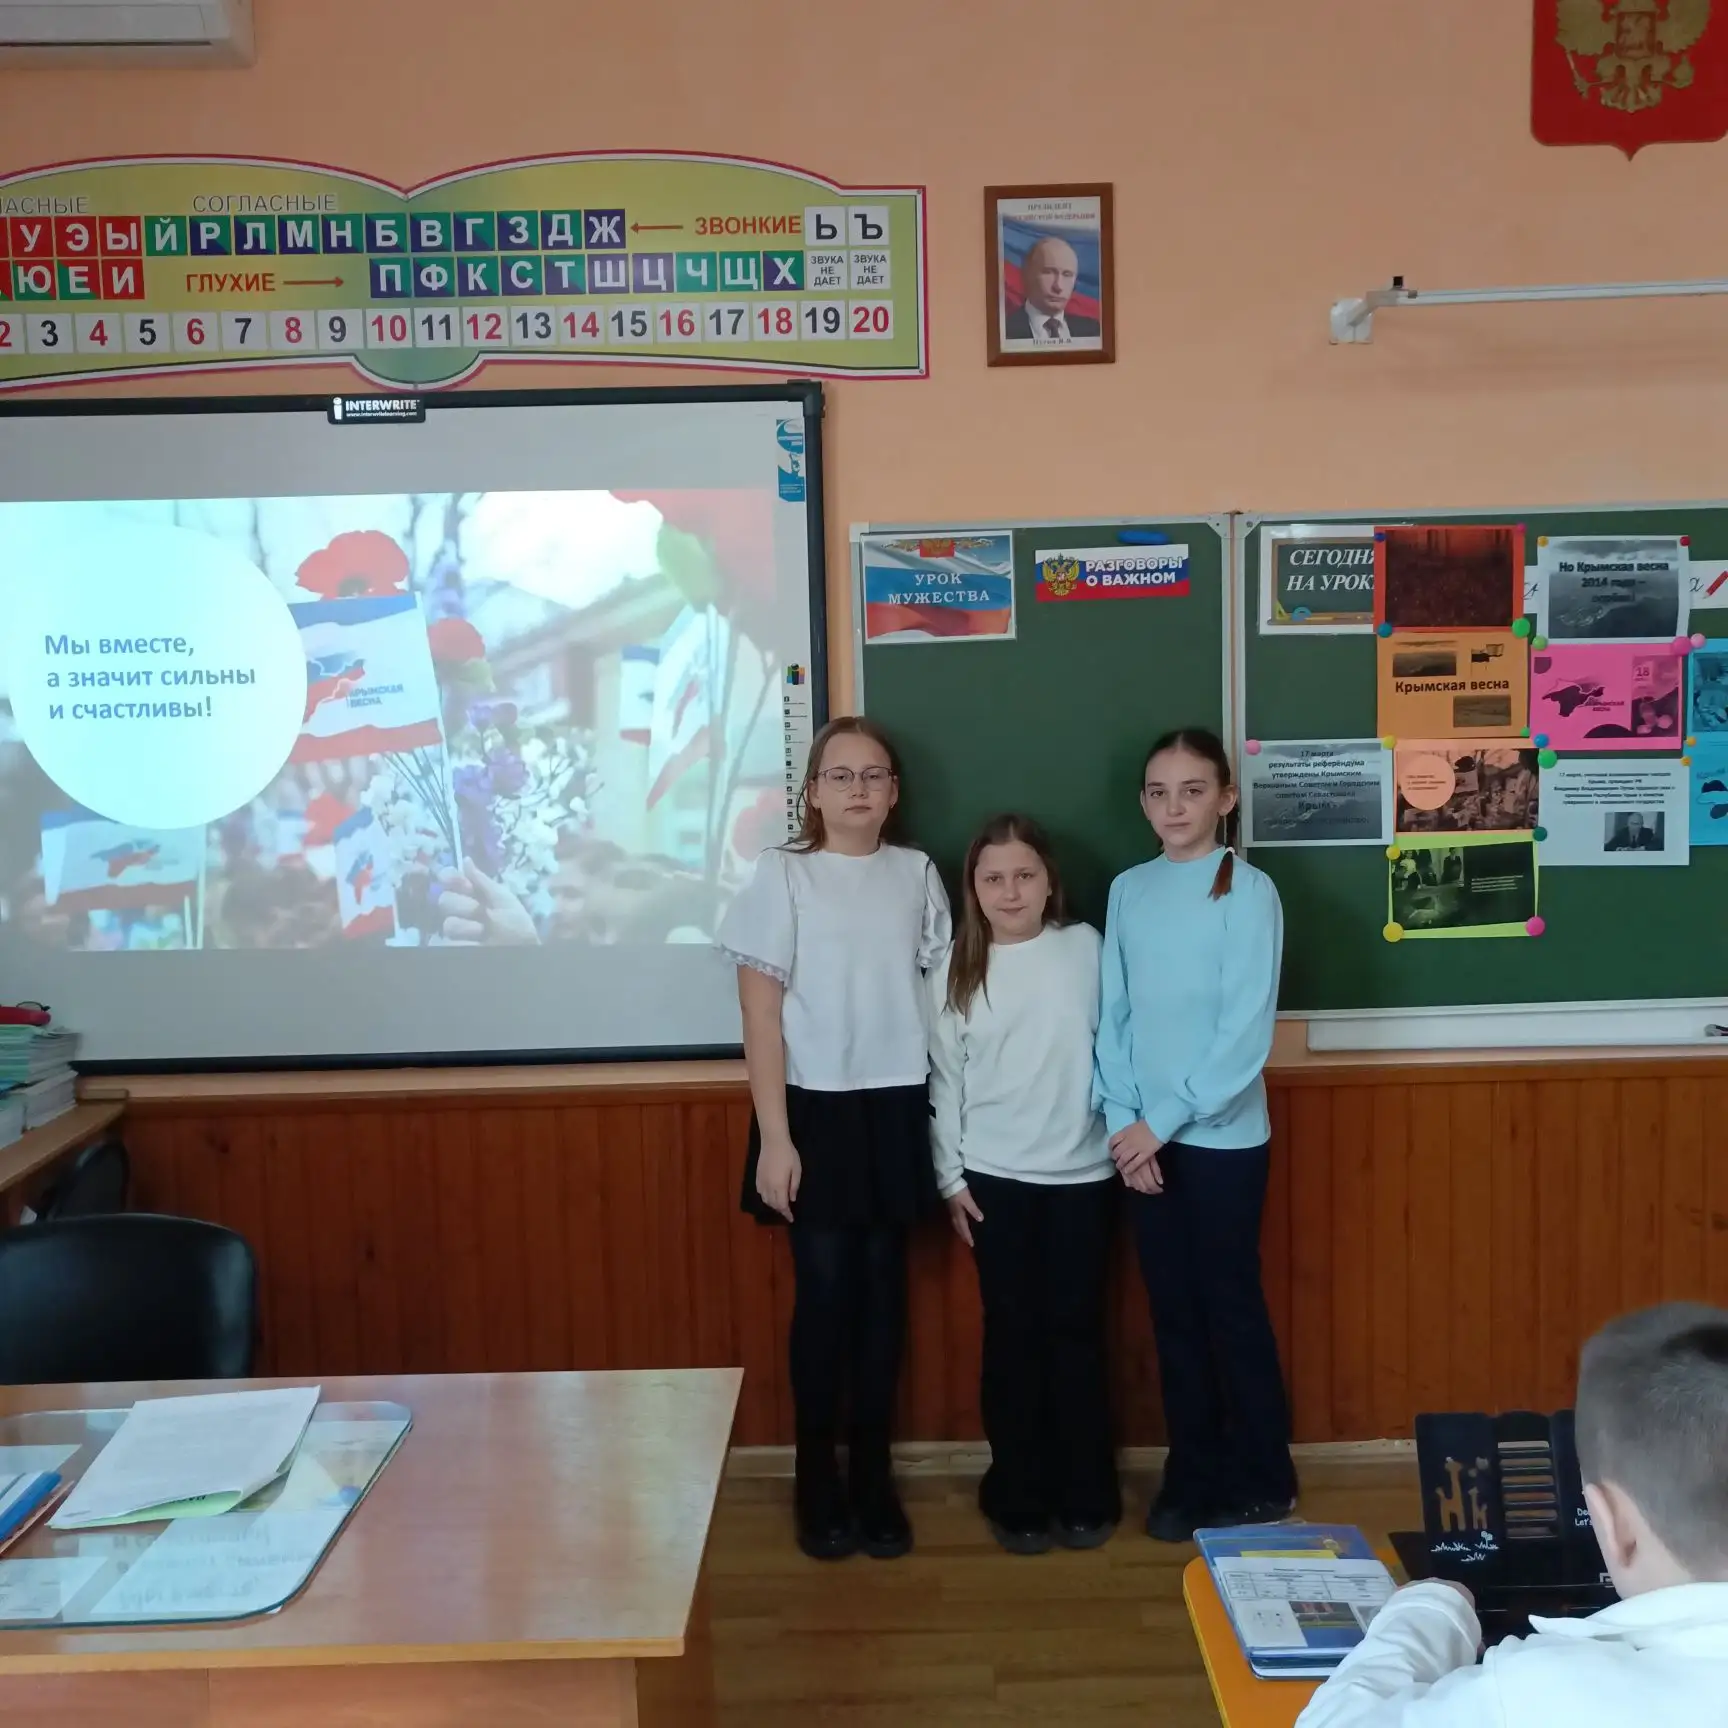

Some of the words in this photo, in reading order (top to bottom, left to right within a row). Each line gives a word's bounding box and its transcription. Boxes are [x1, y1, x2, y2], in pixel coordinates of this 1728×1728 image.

[0, 197, 89, 214] АСНЫЕ
[193, 194, 338, 213] СОГЛАСНЫЕ
[20, 225, 42, 252] У
[66, 223, 90, 251] Э
[106, 223, 138, 250] Ы
[155, 217, 179, 251] Й
[200, 222, 221, 250] Р
[243, 223, 267, 250] Л
[287, 222, 313, 248] М
[330, 221, 352, 247] Н
[376, 220, 399, 247] Б
[421, 220, 443, 247] В
[465, 218, 484, 246] Г
[509, 216, 529, 244] З
[547, 214, 573, 246] Д
[589, 216, 620, 243] Ж
[694, 215, 801, 236] ЗВОНКИЕ
[854, 214, 883, 240] Ъ
[811, 255, 843, 264] ЗВУКА
[854, 254, 887, 263] ЗВУКА
[380, 263, 401, 291] П
[420, 263, 448, 291] Ф
[469, 263, 487, 291] К
[510, 260, 534, 288] С
[555, 261, 576, 288] Т
[594, 260, 626, 287] Ш
[642, 259, 667, 290] Ц
[687, 258, 709, 286] Ч
[725, 257, 758, 289] Щ
[773, 257, 796, 285] Х
[821, 266, 834, 275] НЕ
[864, 265, 877, 273] НЕ
[17, 265, 51, 294] Ю
[68, 265, 90, 294] Е
[112, 266, 135, 295] И
[186, 272, 276, 292] ГЛУХИЕ
[814, 276, 841, 287] ДАЕТ
[857, 275, 884, 286] ДАЕТ
[41, 320, 58, 346] 3
[89, 319, 108, 346] 4
[139, 319, 156, 345] 5
[187, 318, 205, 345] 6
[234, 318, 252, 344] 7
[285, 317, 302, 343] 8
[329, 316, 347, 342] 9
[372, 315, 407, 341] 10
[422, 314, 452, 341] 11
[466, 313, 502, 340] 12
[516, 312, 552, 339] 13
[563, 311, 599, 338] 14
[611, 310, 647, 338] 15
[660, 309, 695, 337] 16
[710, 309, 745, 336] 17
[758, 307, 793, 335] 18
[805, 306, 840, 334] 19
[853, 306, 889, 333] 20
[345, 399, 417, 411] INTERWRITE
[1085, 557, 1183, 573] РАЗГОВОРЫ
[1559, 562, 1574, 572] Но
[914, 572, 963, 585] УРОК
[1086, 575, 1097, 587] О
[1101, 572, 1176, 586] ВАЖНОМ
[1286, 575, 1315, 591] НА
[1320, 574, 1374, 591] УРОК
[888, 590, 990, 605] МУЖЕСТВА
[45, 635, 90, 655] Мы
[99, 637, 194, 656] вместе,
[47, 672, 60, 687] а
[68, 670, 153, 687] значит
[160, 668, 256, 686] сильны
[1636, 666, 1650, 678] 18
[1395, 680, 1466, 695] Крымская
[1470, 679, 1510, 690] весна
[49, 704, 64, 719] и
[72, 695, 212, 720] счастливы!
